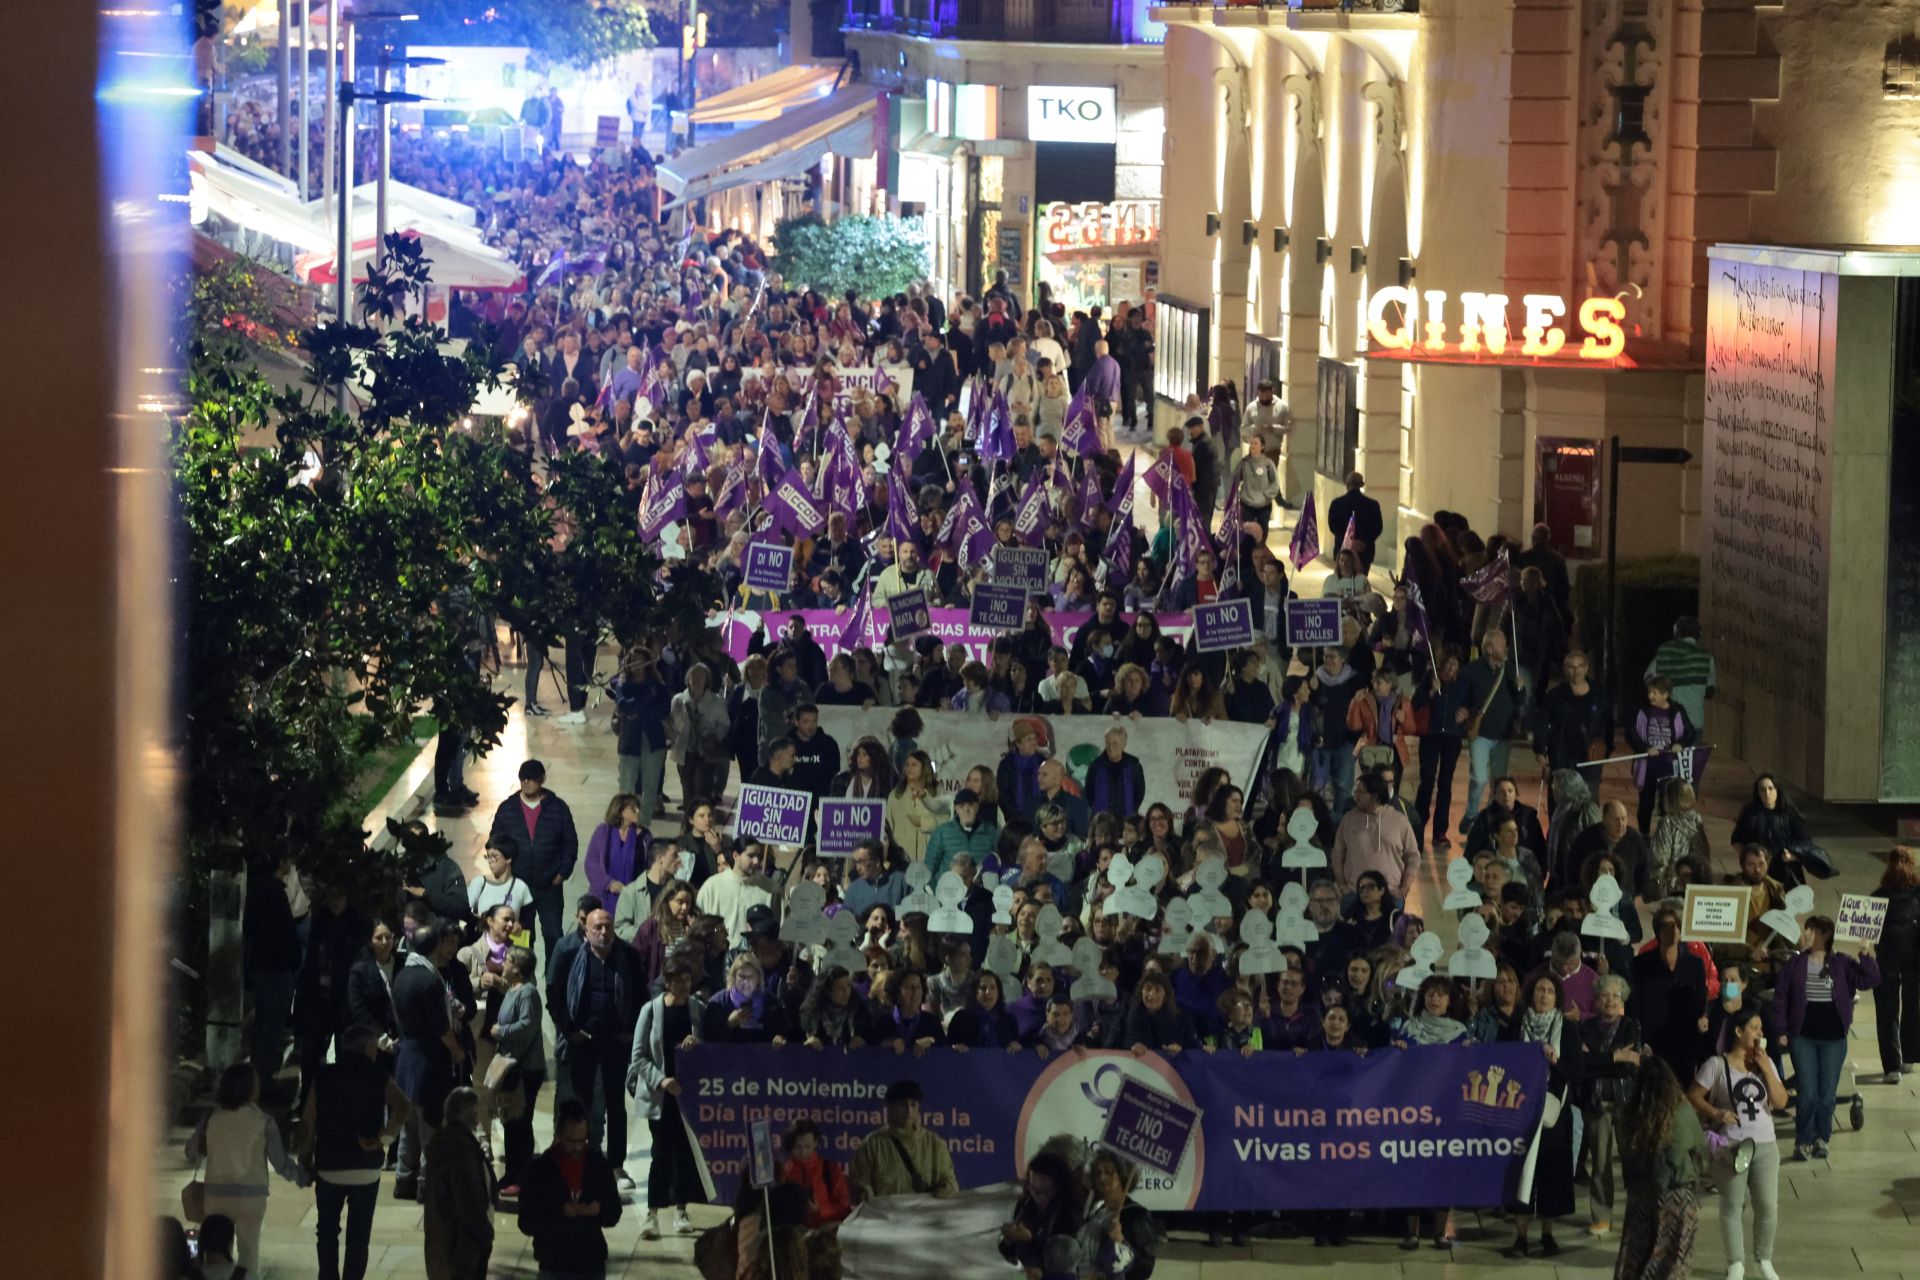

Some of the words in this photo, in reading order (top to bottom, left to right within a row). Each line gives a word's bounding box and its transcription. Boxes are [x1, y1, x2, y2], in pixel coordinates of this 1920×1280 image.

[1037, 98, 1103, 121] TKO
[1367, 285, 1627, 359] CINES
[789, 493, 820, 526] CCOO
[757, 552, 766, 566] DI
[768, 550, 784, 568] NO
[998, 550, 1045, 566] IGUALDAD
[1012, 564, 1029, 577] SIN
[895, 610, 915, 628] MATA
[979, 611, 988, 623] TE
[988, 611, 1018, 626] CALLES!
[1205, 611, 1217, 626] DI
[1220, 605, 1240, 625] NO
[777, 623, 841, 638] CTRA
[1295, 629, 1304, 641] TE
[1304, 628, 1334, 641] CALLES!
[1184, 759, 1211, 769] CONTRA
[744, 788, 806, 812] IGUALDAD
[761, 807, 783, 824] SIN
[833, 808, 845, 827] DI
[850, 804, 871, 827] NO
[739, 818, 800, 842] VIOLENCIA
[829, 829, 835, 838] A
[836, 829, 843, 839] la
[698, 1078, 725, 1097] 25
[731, 1078, 760, 1097] de
[767, 1077, 888, 1099] Noviembre
[699, 1102, 736, 1123] Día
[743, 1104, 888, 1126] Internacional
[951, 1106, 971, 1127] la
[1233, 1104, 1265, 1128] Ni
[1273, 1108, 1327, 1127] una
[1335, 1104, 1442, 1127] menos,
[1135, 1111, 1164, 1141] ¡NO
[835, 1130, 861, 1152] de
[1114, 1126, 1130, 1147] TE
[1128, 1133, 1173, 1167] CALLES!
[1233, 1137, 1312, 1162] Vivas
[1319, 1141, 1372, 1160] nos
[1378, 1136, 1526, 1165] queremos
